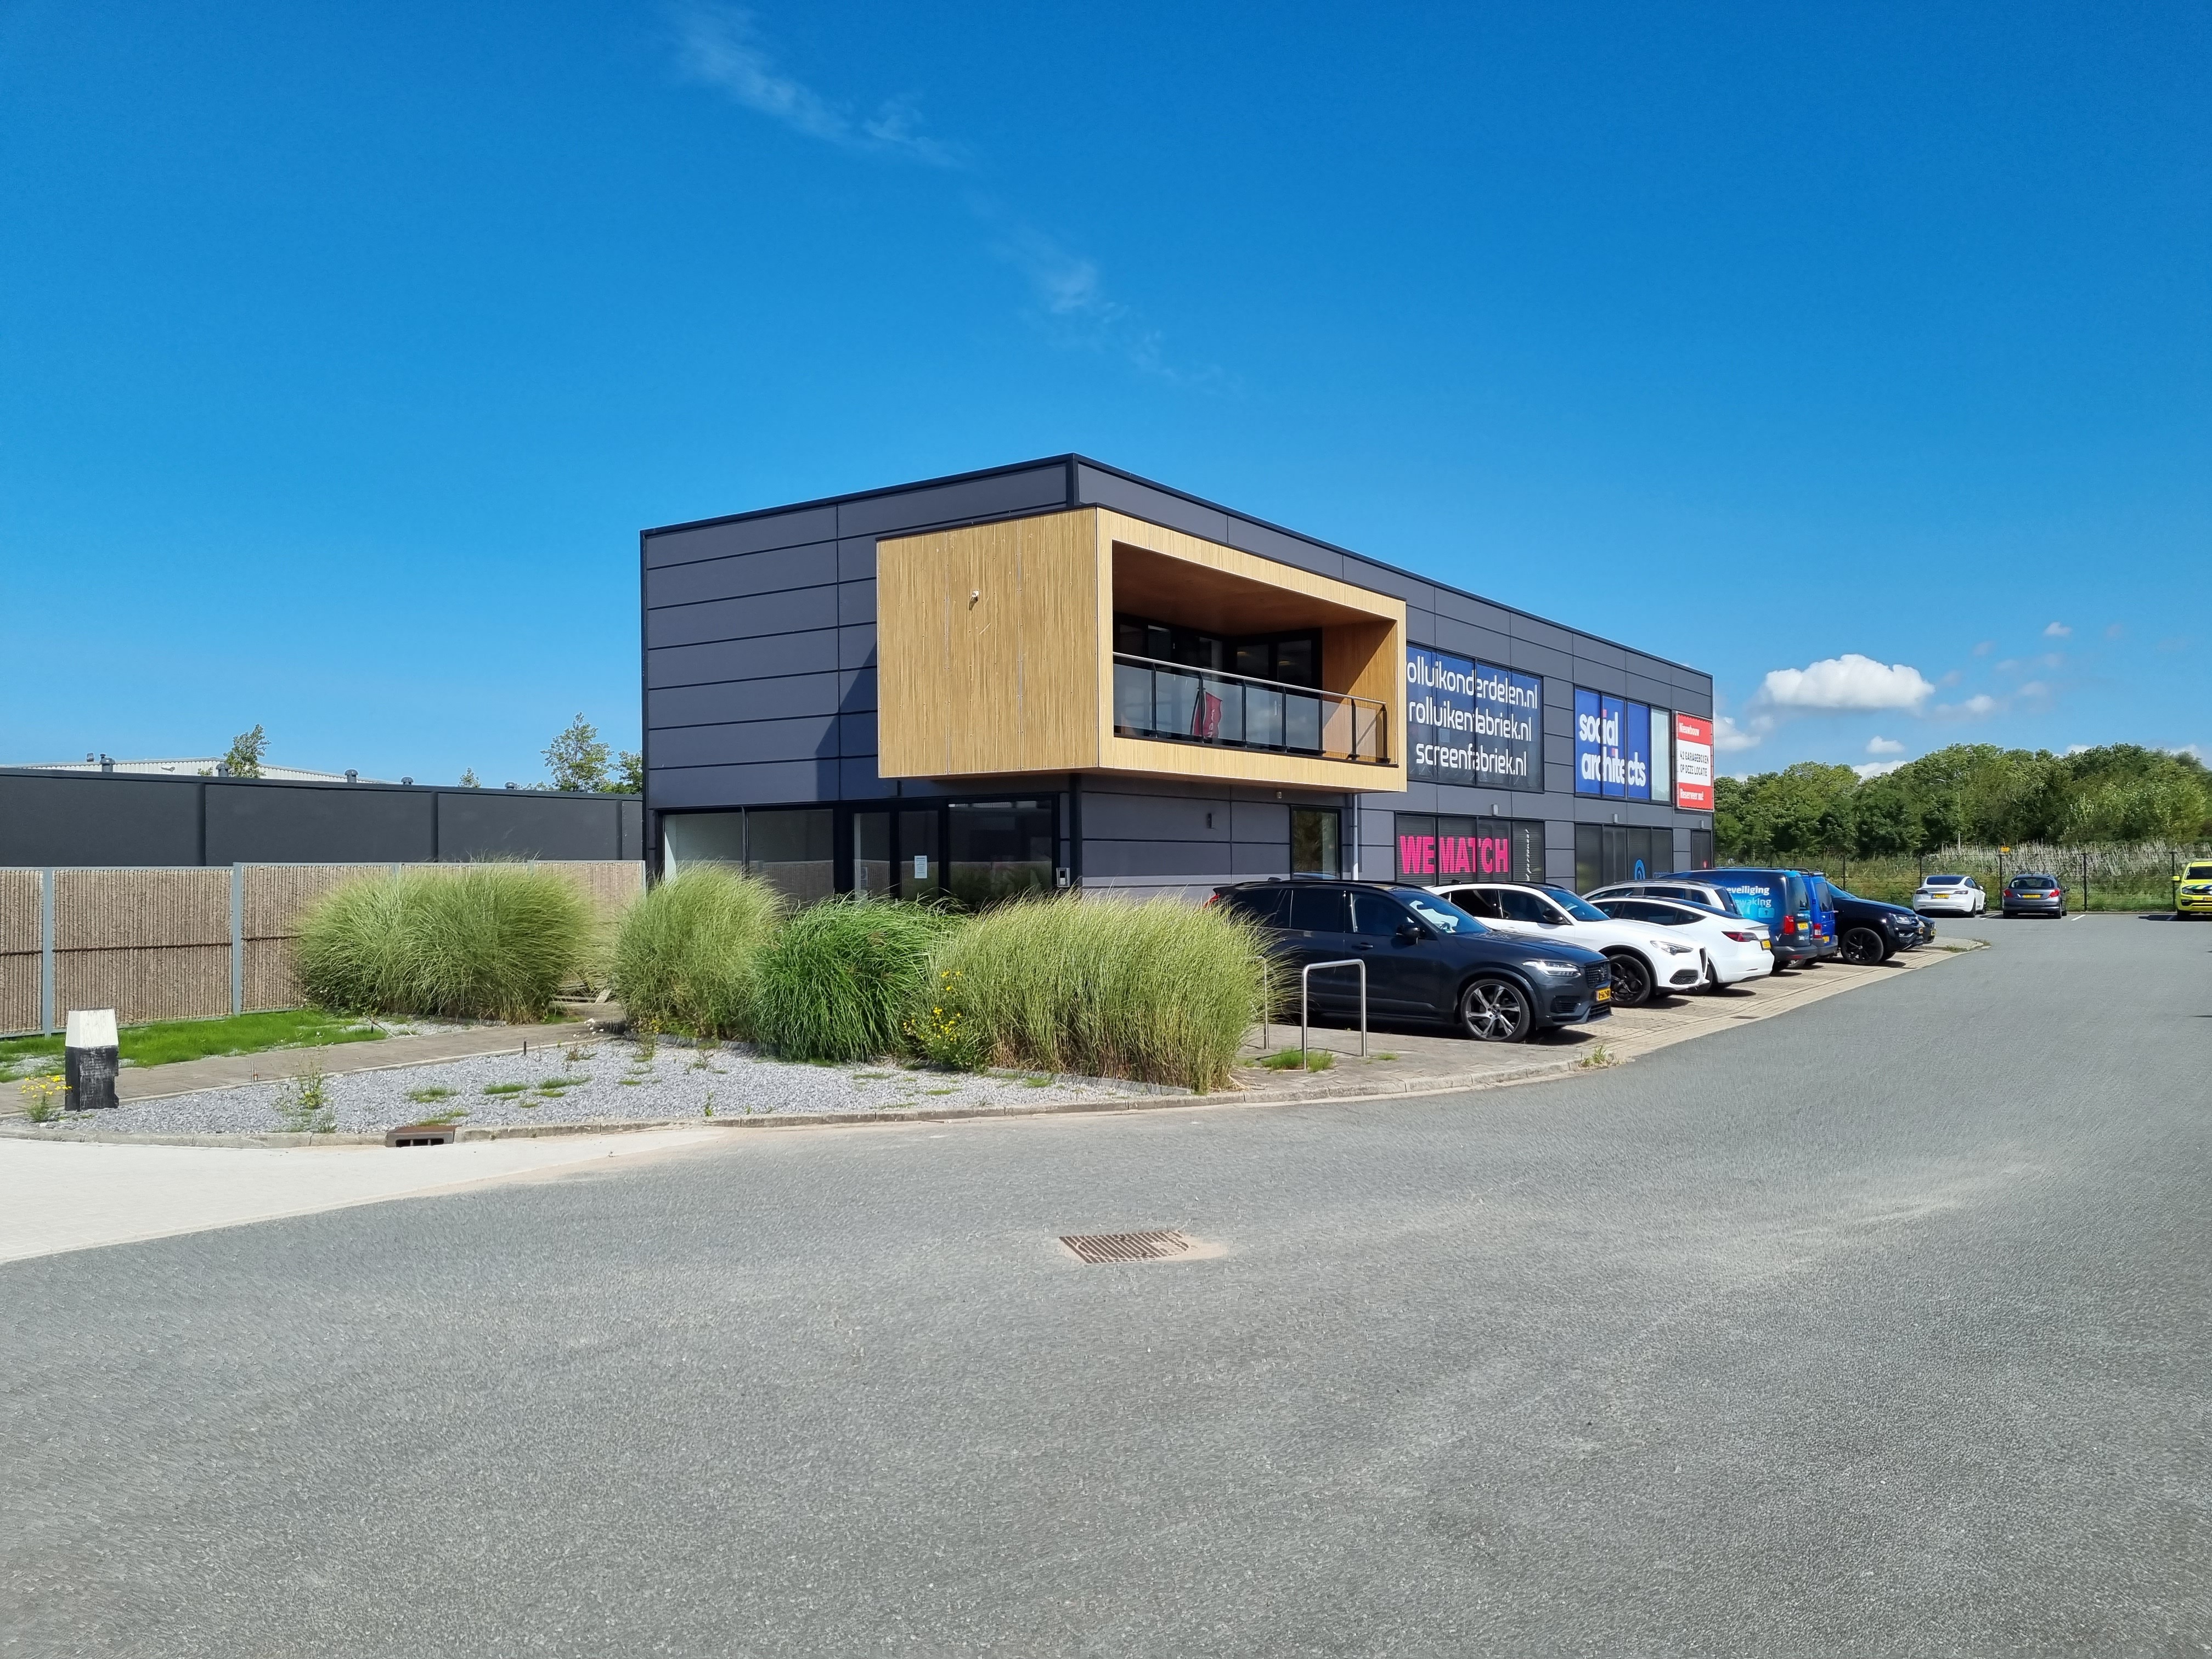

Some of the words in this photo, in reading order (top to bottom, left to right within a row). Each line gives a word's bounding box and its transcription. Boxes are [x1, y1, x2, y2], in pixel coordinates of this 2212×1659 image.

[1406, 656, 1537, 709] olluikonderdelen.nl
[1409, 696, 1531, 741] rolluikenfabriek.nl
[1579, 709, 1618, 746] social
[1679, 723, 1700, 736] Nieuwbouw
[1416, 743, 1527, 776] screenfabriek.nl
[1582, 747, 1646, 787] architects
[1680, 751, 1685, 760] 42
[1685, 752, 1709, 764] GARAGEBOXEN
[1680, 764, 1685, 773] OP
[1685, 765, 1694, 775] DEZE
[1694, 766, 1707, 777] LOCATIE
[1400, 836, 1435, 874] WE
[1440, 837, 1508, 873] MATCH
[1726, 886, 1770, 895] eveiliging
[1734, 898, 1771, 907] ewaking
